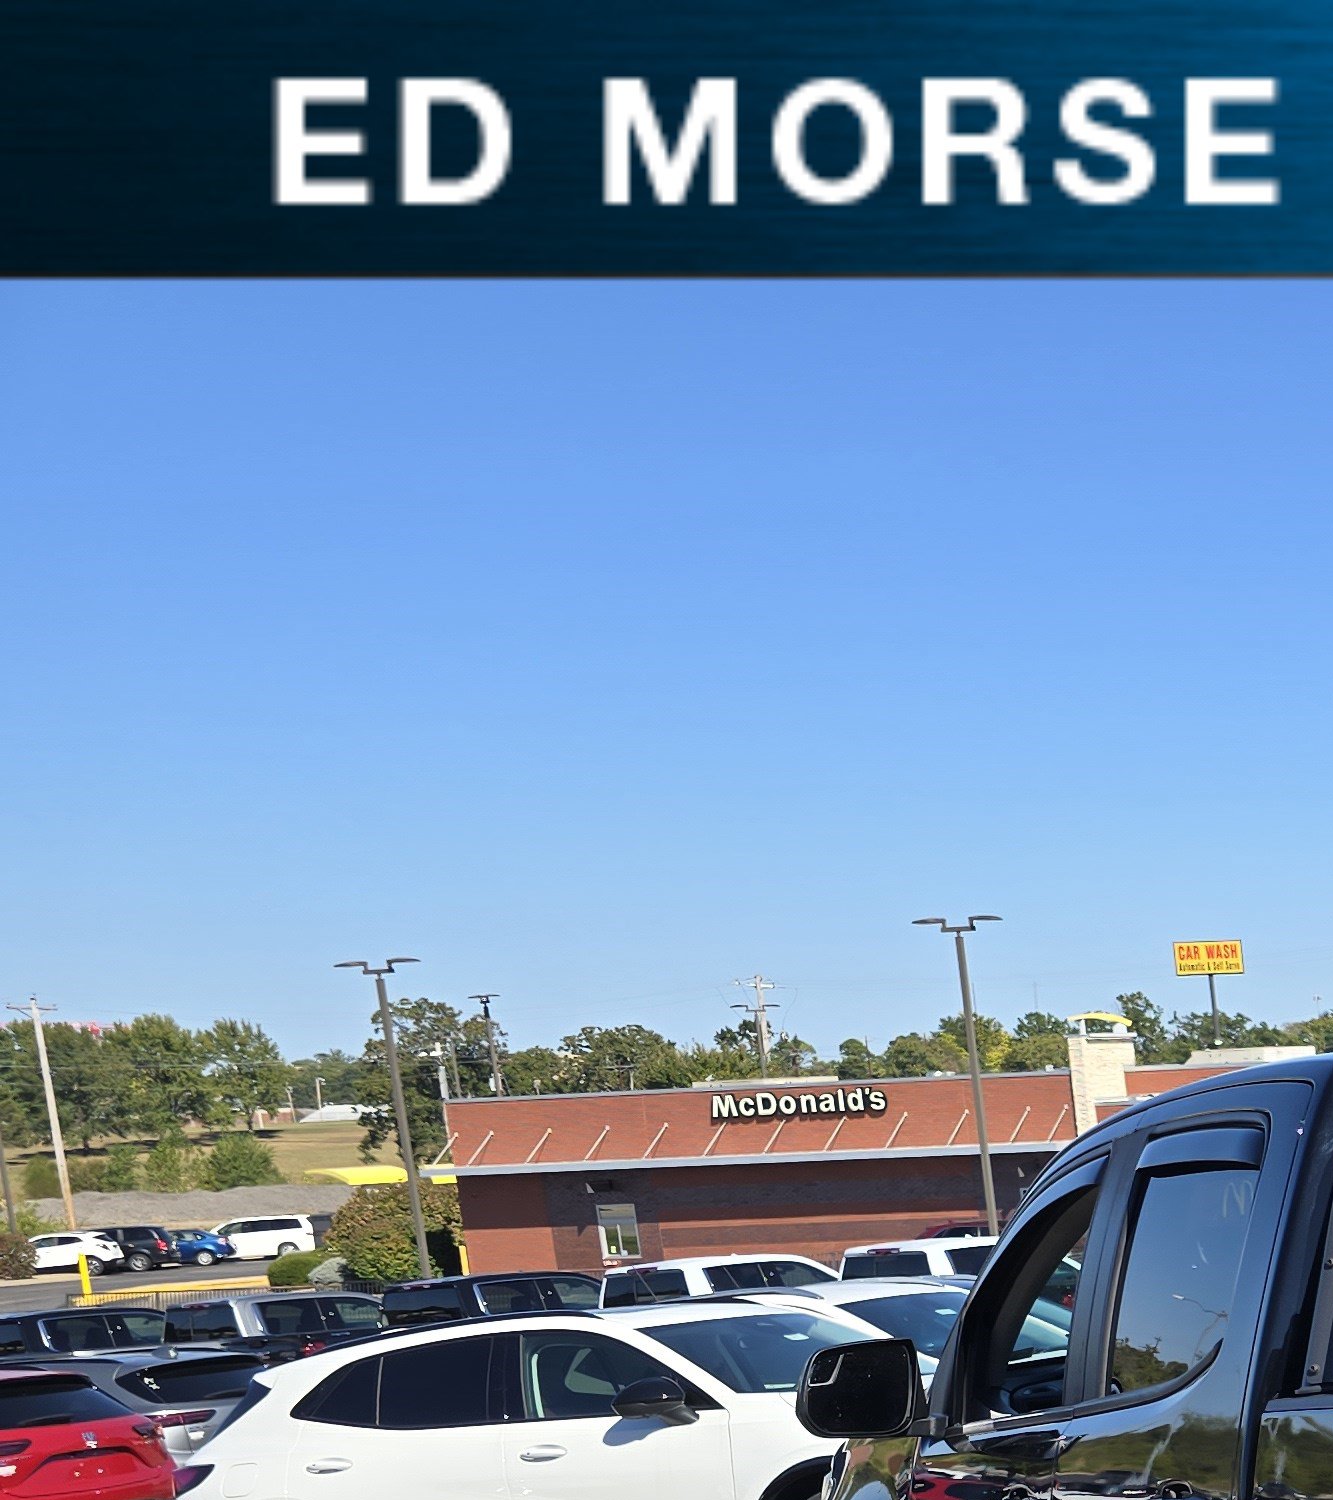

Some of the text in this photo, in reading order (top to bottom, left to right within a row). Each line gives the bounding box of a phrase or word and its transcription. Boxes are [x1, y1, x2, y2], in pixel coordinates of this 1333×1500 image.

[1178, 944, 1238, 961] CAR WASH
[711, 1087, 887, 1119] McDonald's
